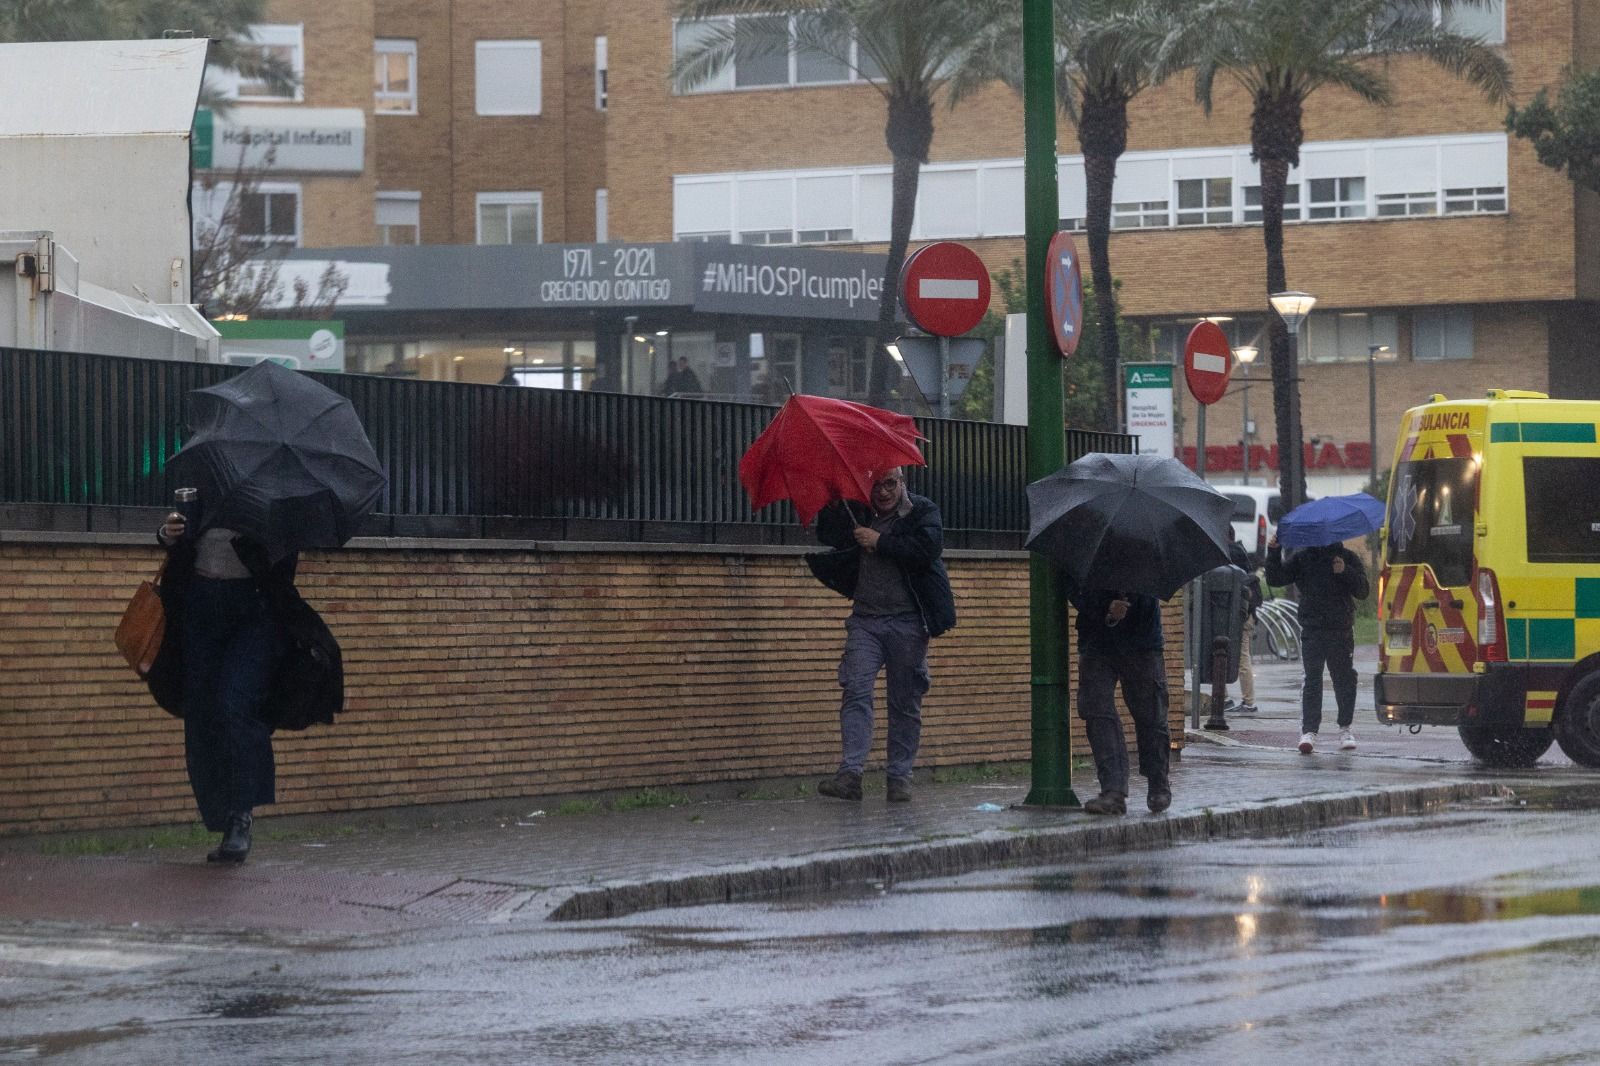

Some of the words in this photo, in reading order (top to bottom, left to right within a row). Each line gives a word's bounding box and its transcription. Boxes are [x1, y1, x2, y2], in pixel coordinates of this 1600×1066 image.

[223, 130, 290, 147] Hospital
[293, 131, 352, 146] Infantil
[563, 249, 592, 278] 1971
[614, 248, 656, 277] 2021
[540, 280, 610, 302] CRECIENDO
[613, 278, 671, 301] CONTIGO
